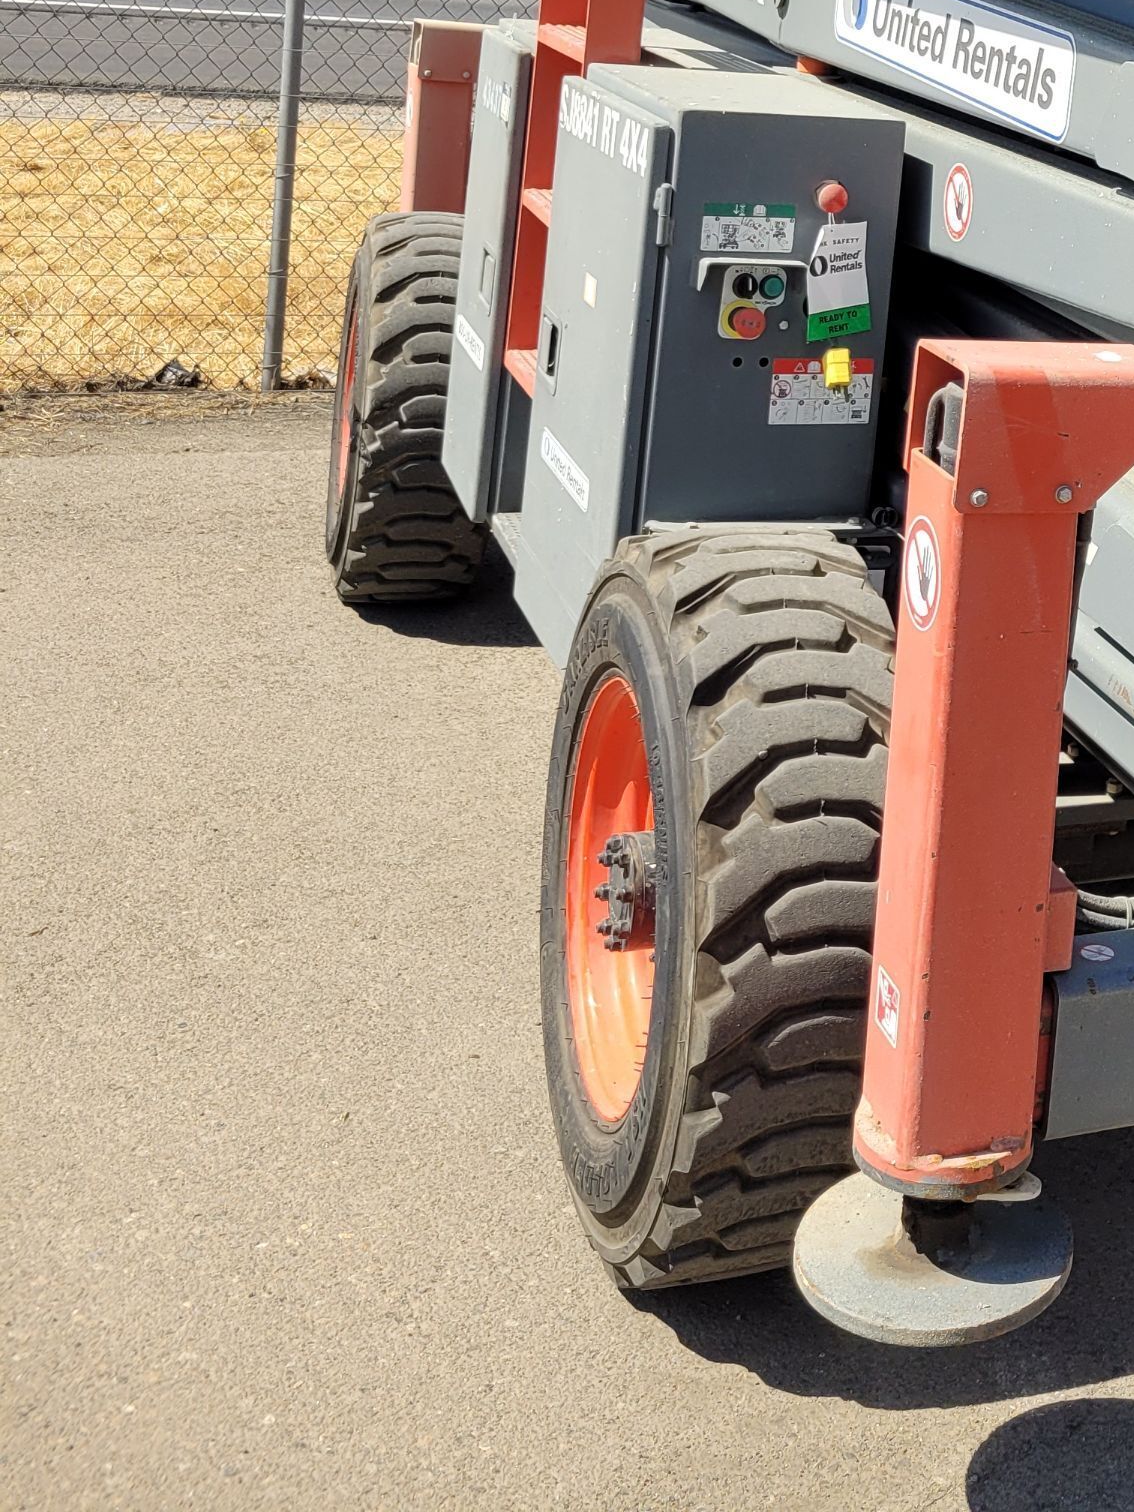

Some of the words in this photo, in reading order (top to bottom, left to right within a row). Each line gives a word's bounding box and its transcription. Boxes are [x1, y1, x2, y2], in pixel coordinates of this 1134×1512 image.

[952, 17, 1056, 110] Rentals
[560, 84, 600, 148] SJ8841
[600, 106, 620, 159] RT
[620, 118, 649, 178] 4X4
[832, 237, 860, 245] SAFETY
[829, 250, 862, 263] United
[829, 261, 863, 274] Rentals
[819, 313, 845, 324] READY
[847, 310, 858, 320] TO
[828, 323, 849, 334] RENT
